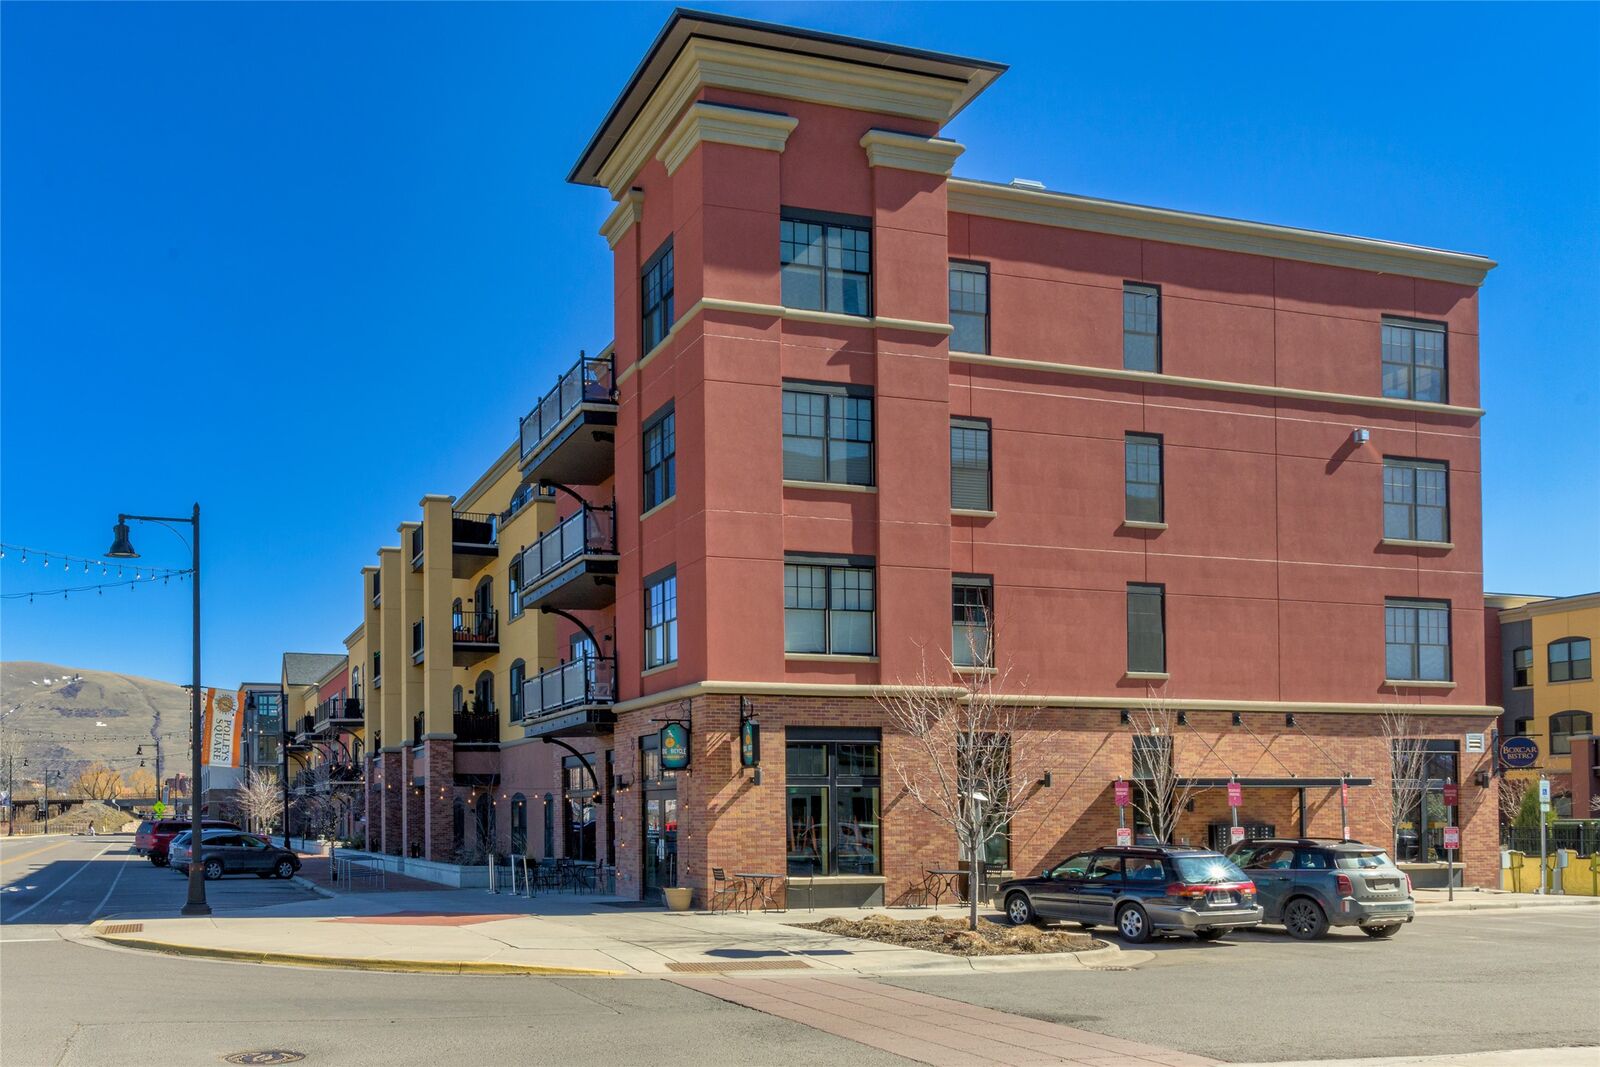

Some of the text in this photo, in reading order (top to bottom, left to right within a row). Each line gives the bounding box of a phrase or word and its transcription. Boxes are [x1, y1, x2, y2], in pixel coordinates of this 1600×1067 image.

[213, 718, 223, 761] SQUARE
[221, 720, 232, 762] POLLEYS
[1503, 746, 1537, 754] BOXCAR
